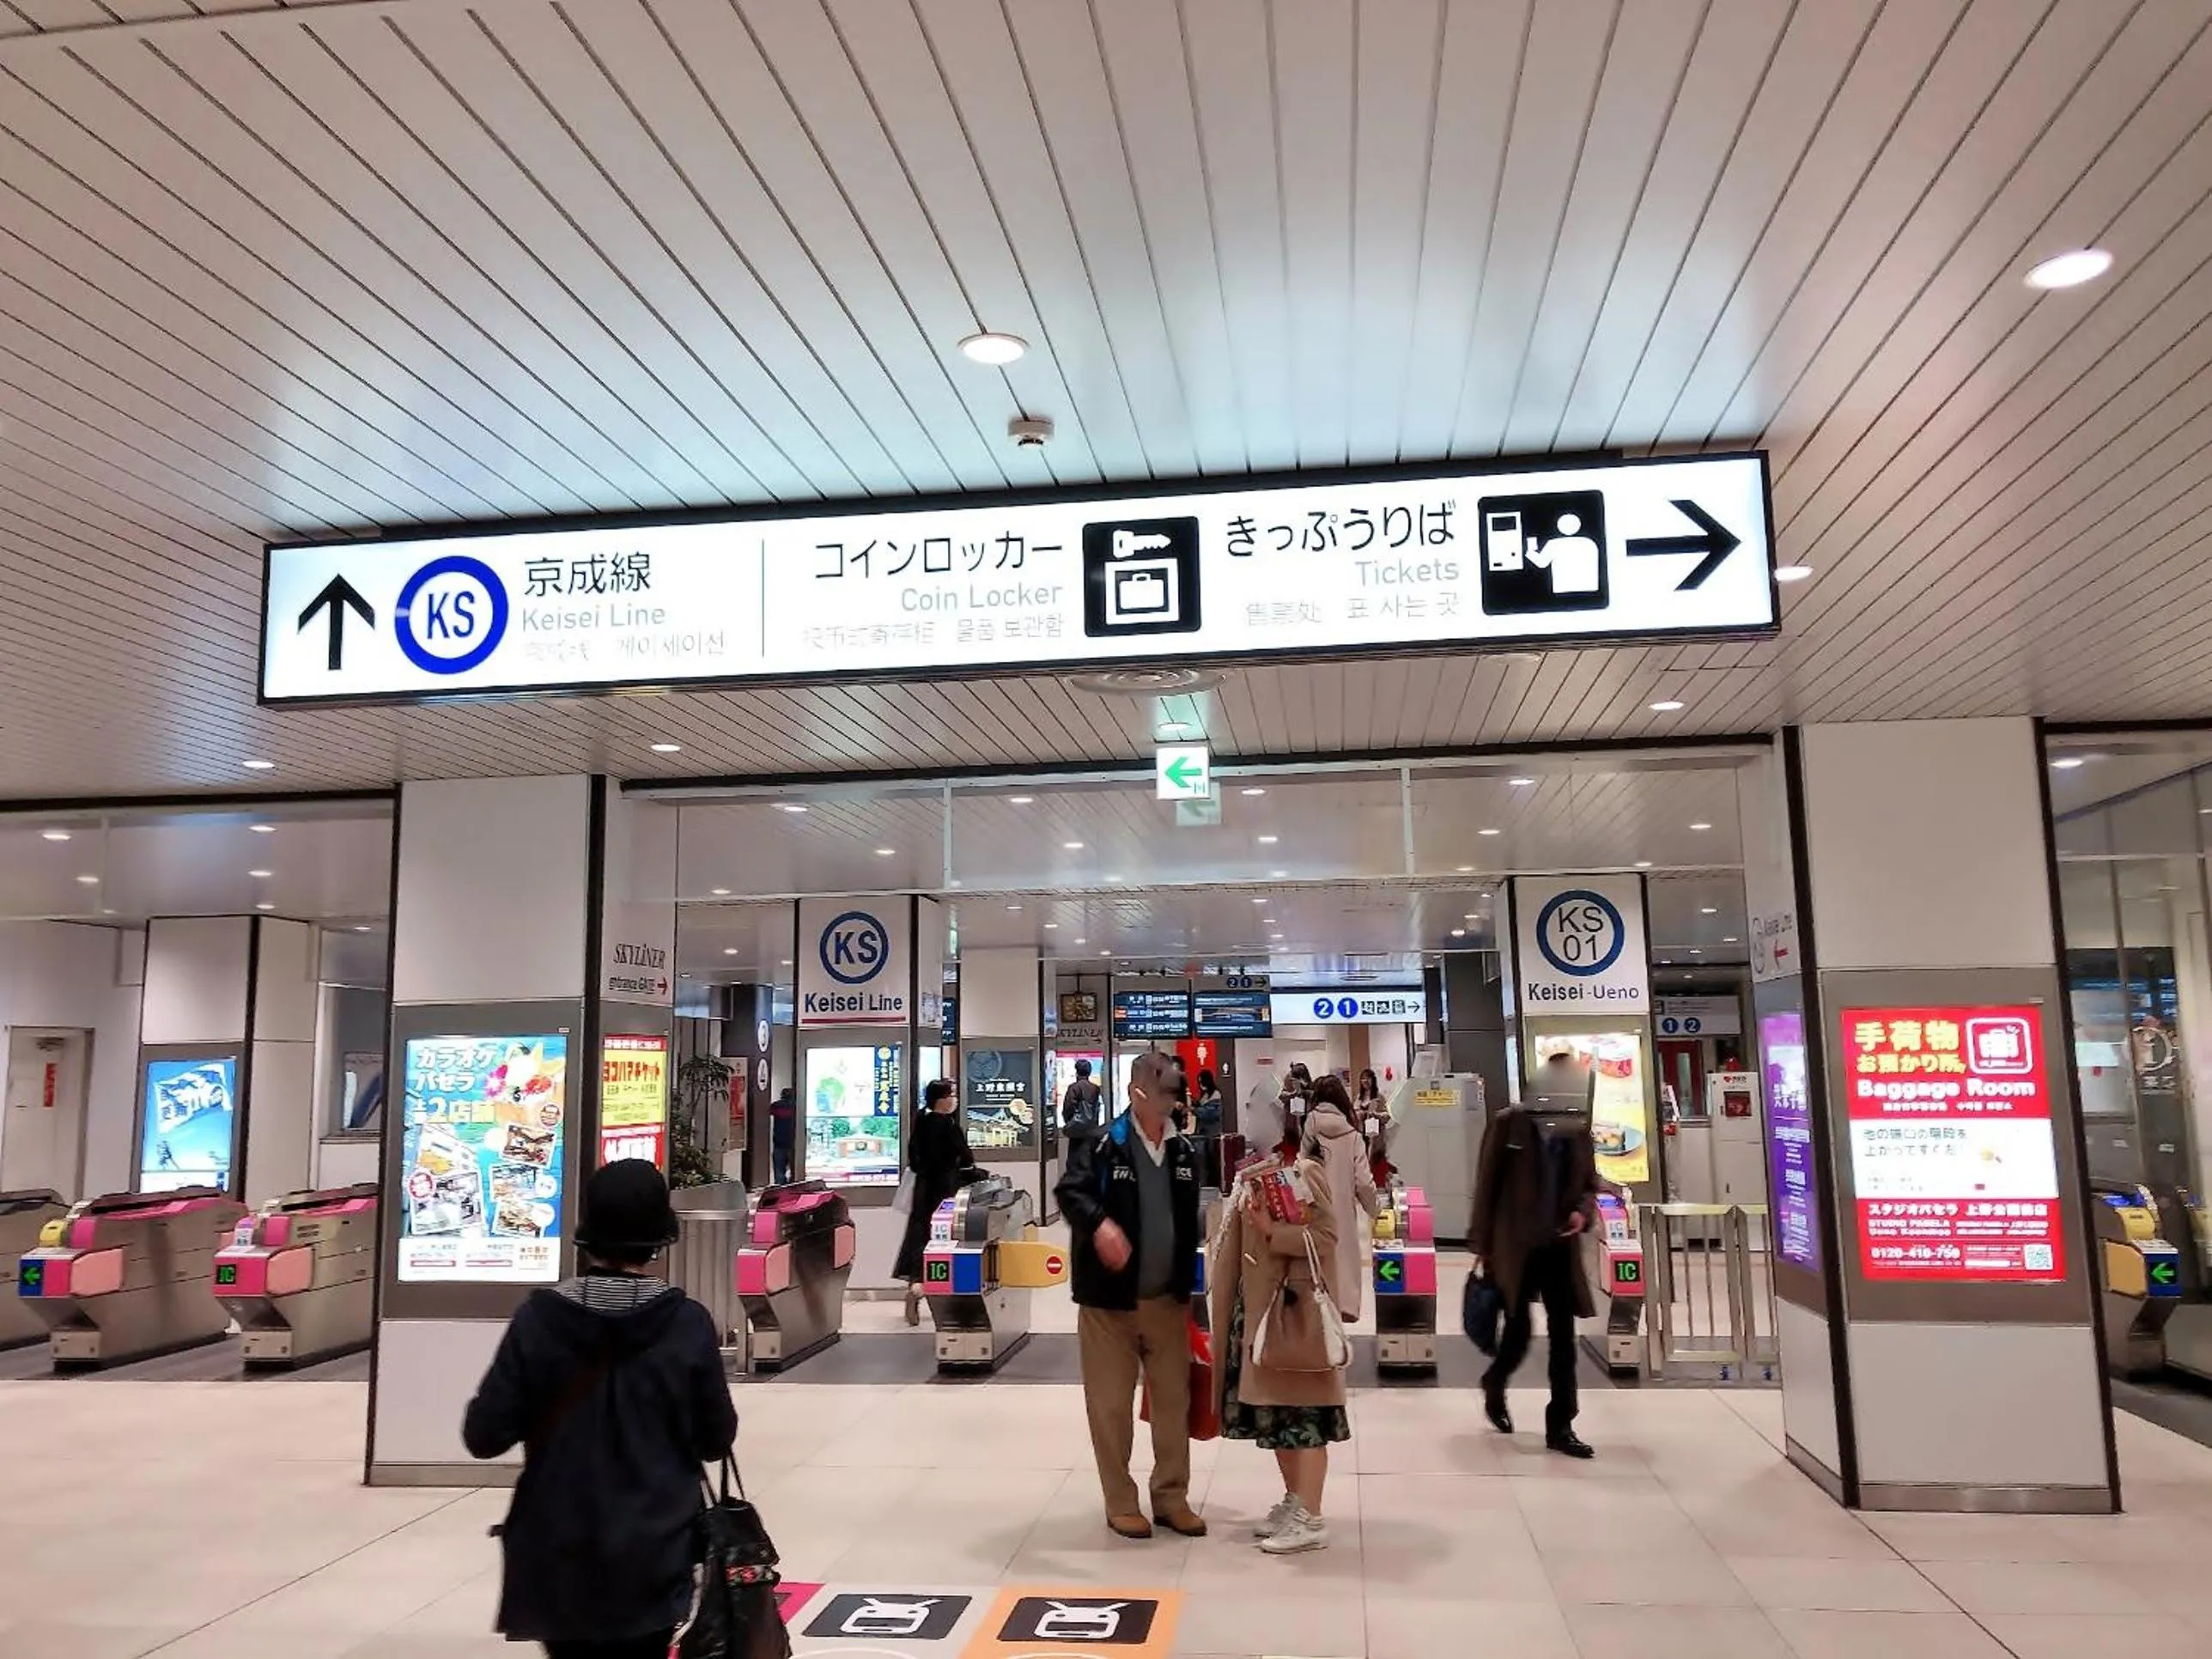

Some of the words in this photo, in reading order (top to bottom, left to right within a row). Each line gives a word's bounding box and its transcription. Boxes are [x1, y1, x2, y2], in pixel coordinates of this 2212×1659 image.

[1226, 498, 1457, 558] きっぷうりば
[814, 529, 1064, 580] コインロッカー
[523, 550, 652, 598] 京成線
[1354, 558, 1460, 587] Tickets
[902, 585, 959, 611] Coin
[969, 580, 1064, 609] Locker
[1379, 593, 1427, 619] 사는
[425, 589, 476, 641] KS
[521, 604, 600, 633] Keisei
[610, 602, 666, 628] Line
[1558, 906, 1604, 933] KS
[834, 929, 878, 965] KS
[1563, 934, 1597, 961] 01
[804, 992, 864, 1013] Keisei
[868, 994, 903, 1012] Line
[1317, 1000, 1329, 1016] 2
[1854, 1019, 1960, 1052] 手荷物
[415, 1042, 498, 1071] カラオケ
[1857, 1079, 1960, 1100] Baggage
[1966, 1078, 2036, 1097] Room
[930, 1262, 947, 1279] IC
[1617, 1262, 1637, 1280] IC
